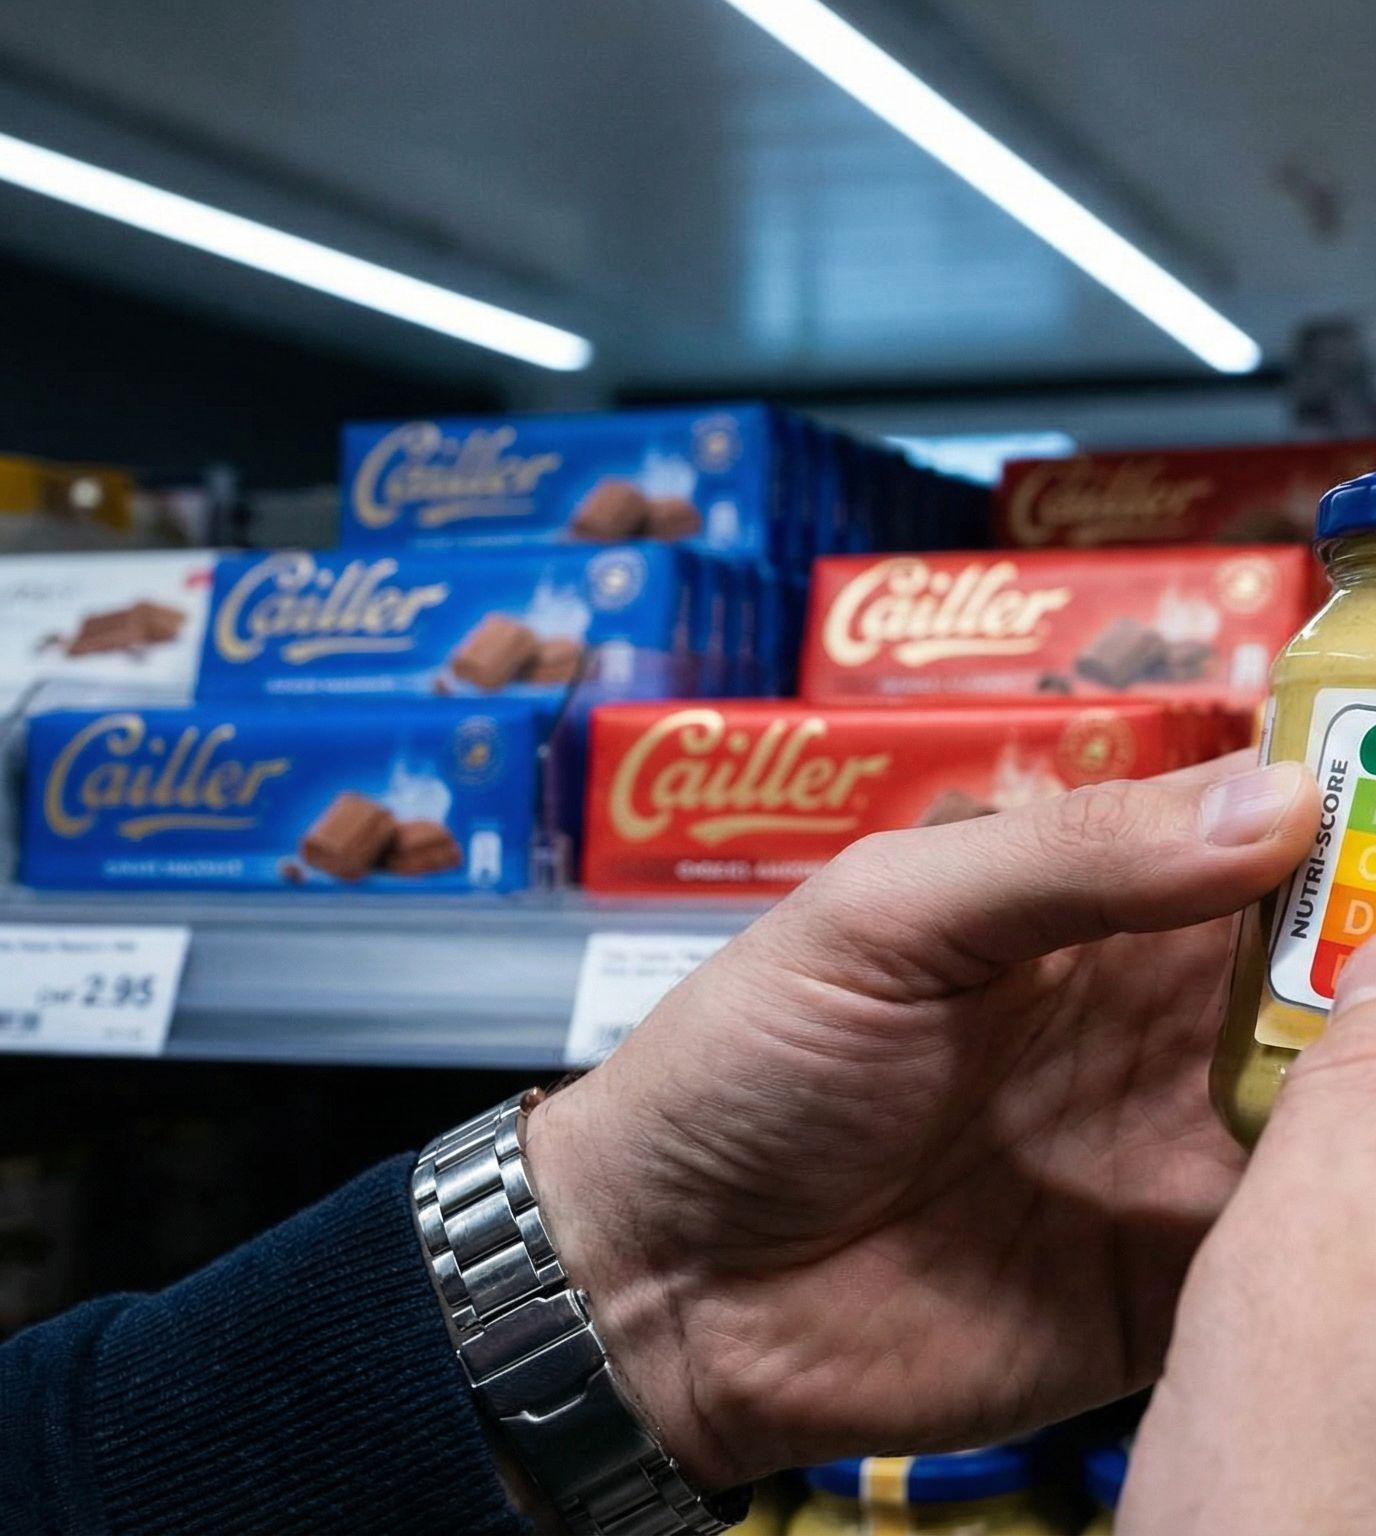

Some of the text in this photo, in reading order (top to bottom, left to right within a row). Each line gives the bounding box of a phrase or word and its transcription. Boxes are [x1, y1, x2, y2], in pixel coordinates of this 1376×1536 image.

[214, 550, 449, 664] Cailler
[822, 556, 1076, 667] Cailler
[44, 713, 292, 838] Cailler
[609, 709, 891, 844] Cailler
[1290, 758, 1348, 940] NUTRI-SCORE
[1342, 899, 1374, 936] D
